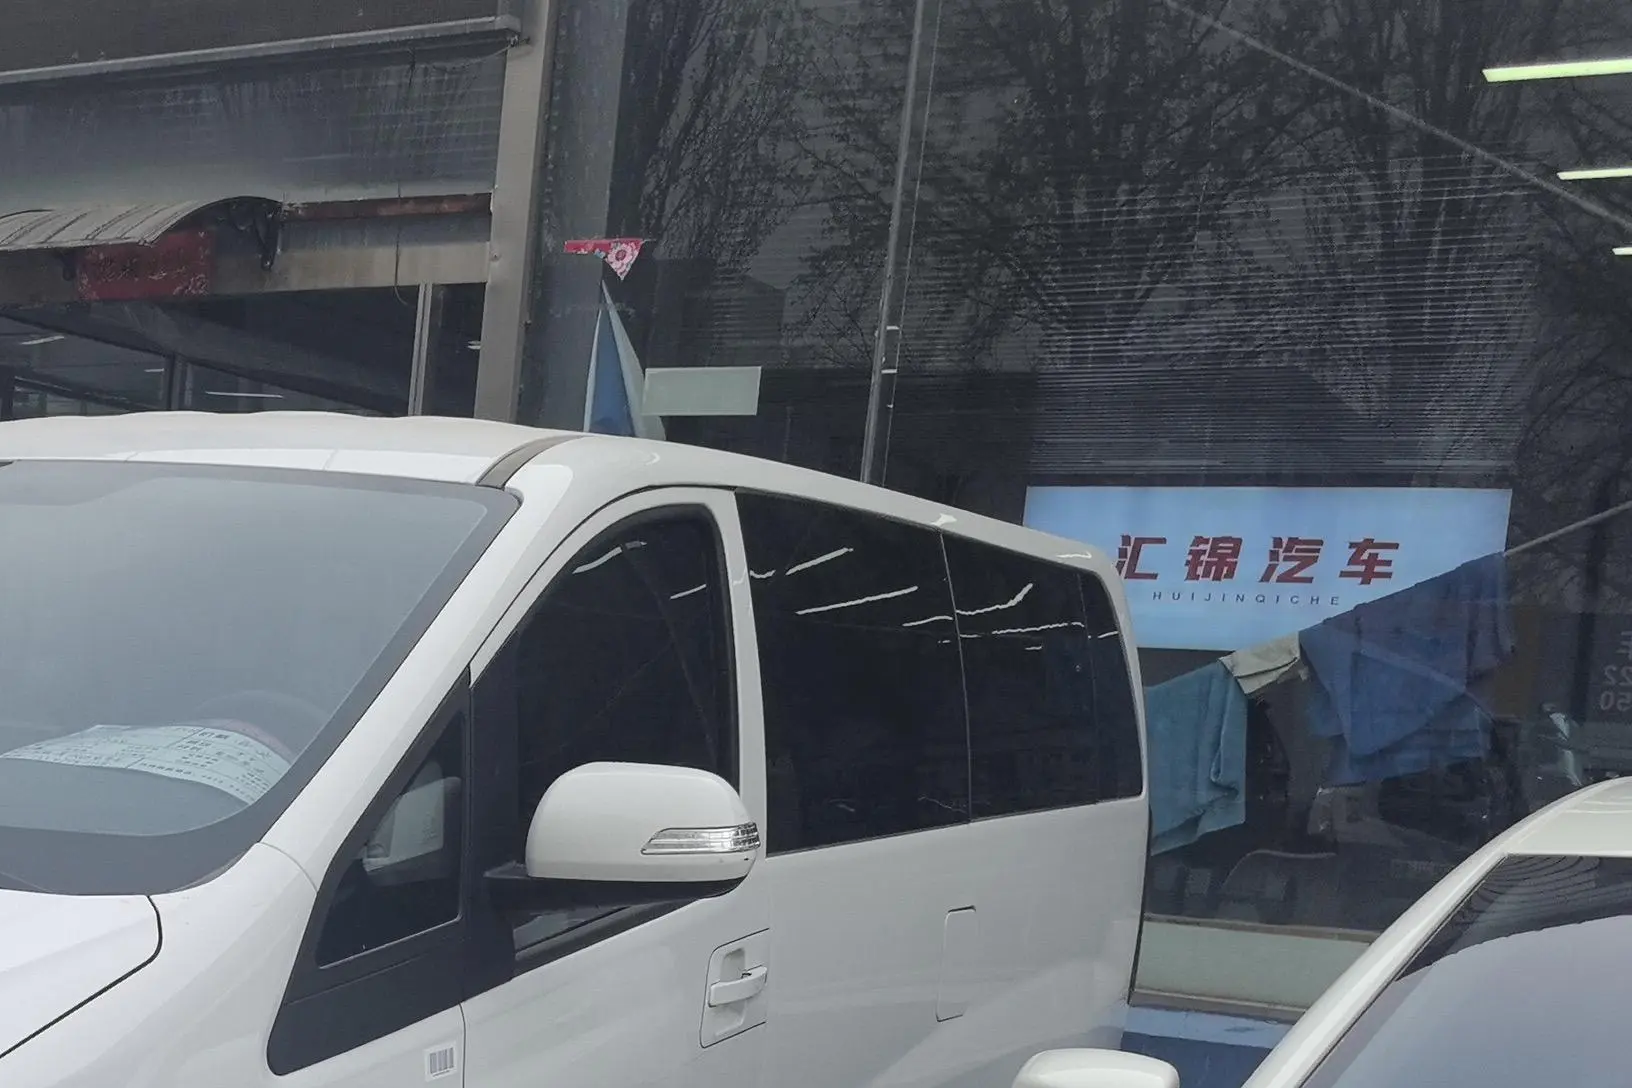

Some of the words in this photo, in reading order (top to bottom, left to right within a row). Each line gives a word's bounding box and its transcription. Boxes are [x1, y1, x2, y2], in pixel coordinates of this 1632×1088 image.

[1116, 534, 1400, 586] 汇锦汽车
[1152, 590, 1341, 607] HUIJINQICHE
